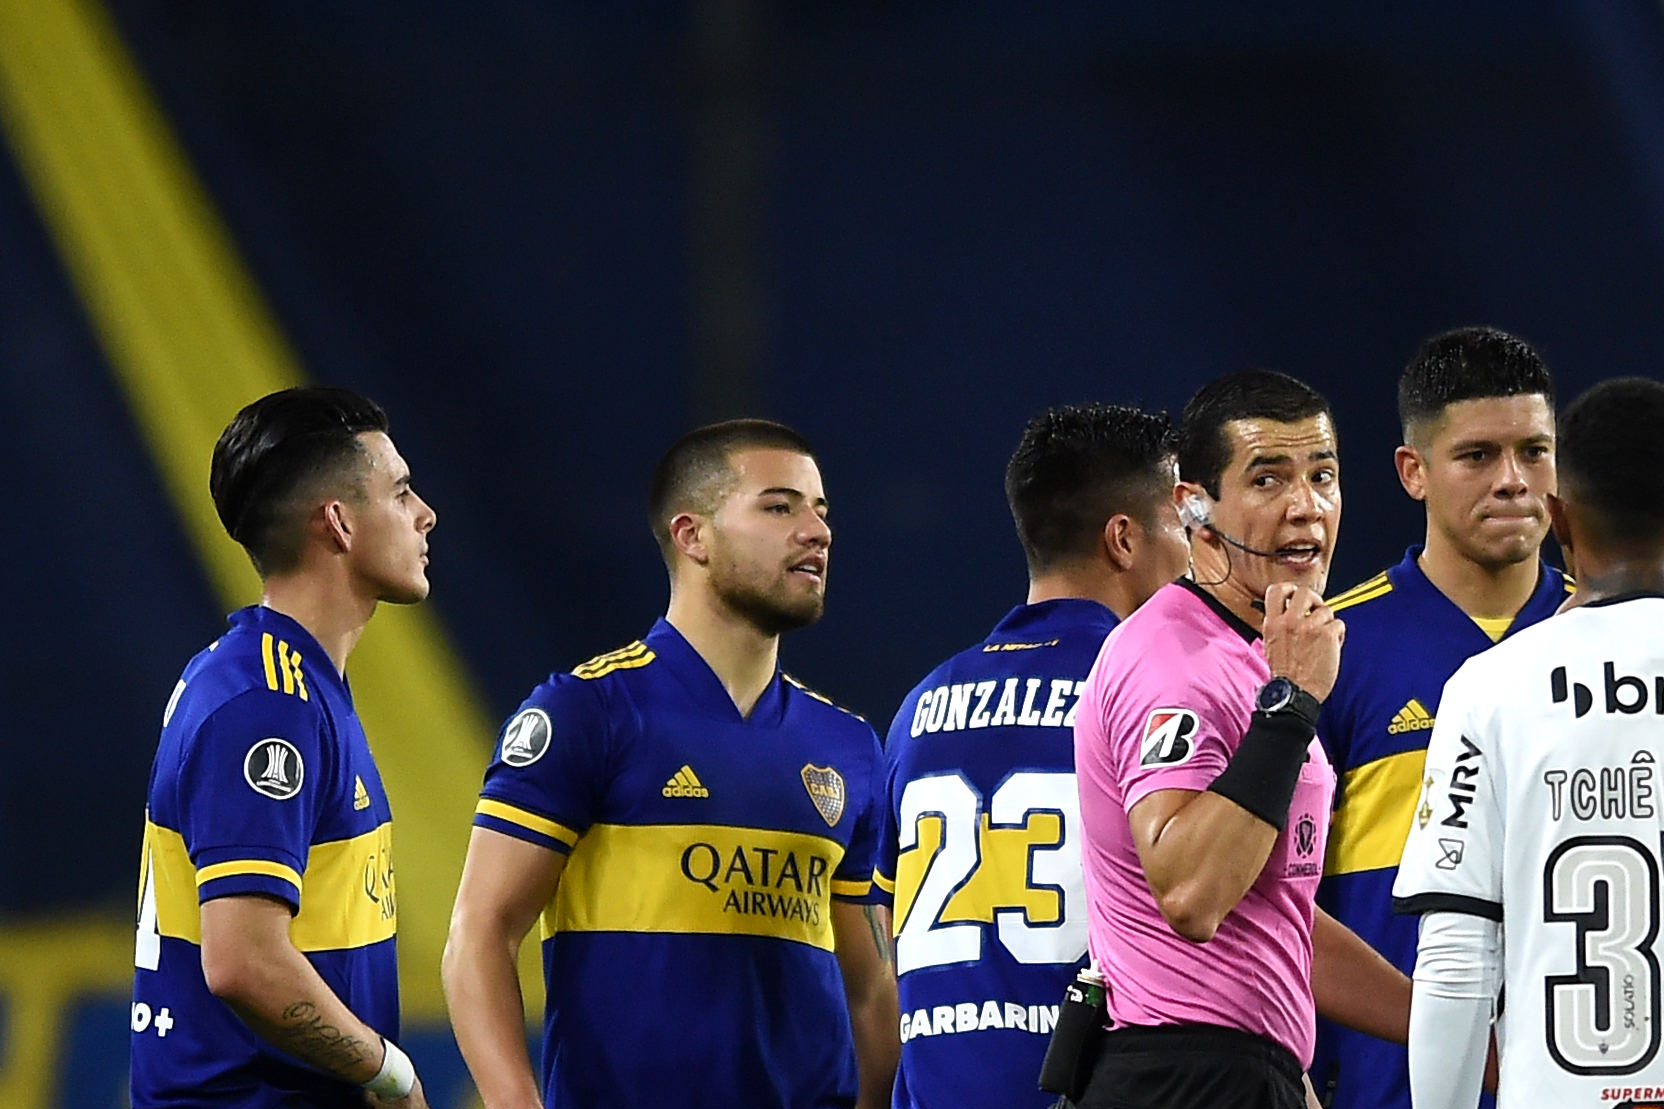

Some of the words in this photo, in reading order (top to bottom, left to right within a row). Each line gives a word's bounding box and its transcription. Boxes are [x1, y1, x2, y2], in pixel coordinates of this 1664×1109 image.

[662, 785, 709, 798] adidas
[1440, 733, 1483, 829] MRV
[1544, 750, 1655, 822] TCHÊ
[681, 842, 827, 897] QATAR
[897, 771, 1089, 977] 23
[723, 890, 821, 926] AIRWAYS
